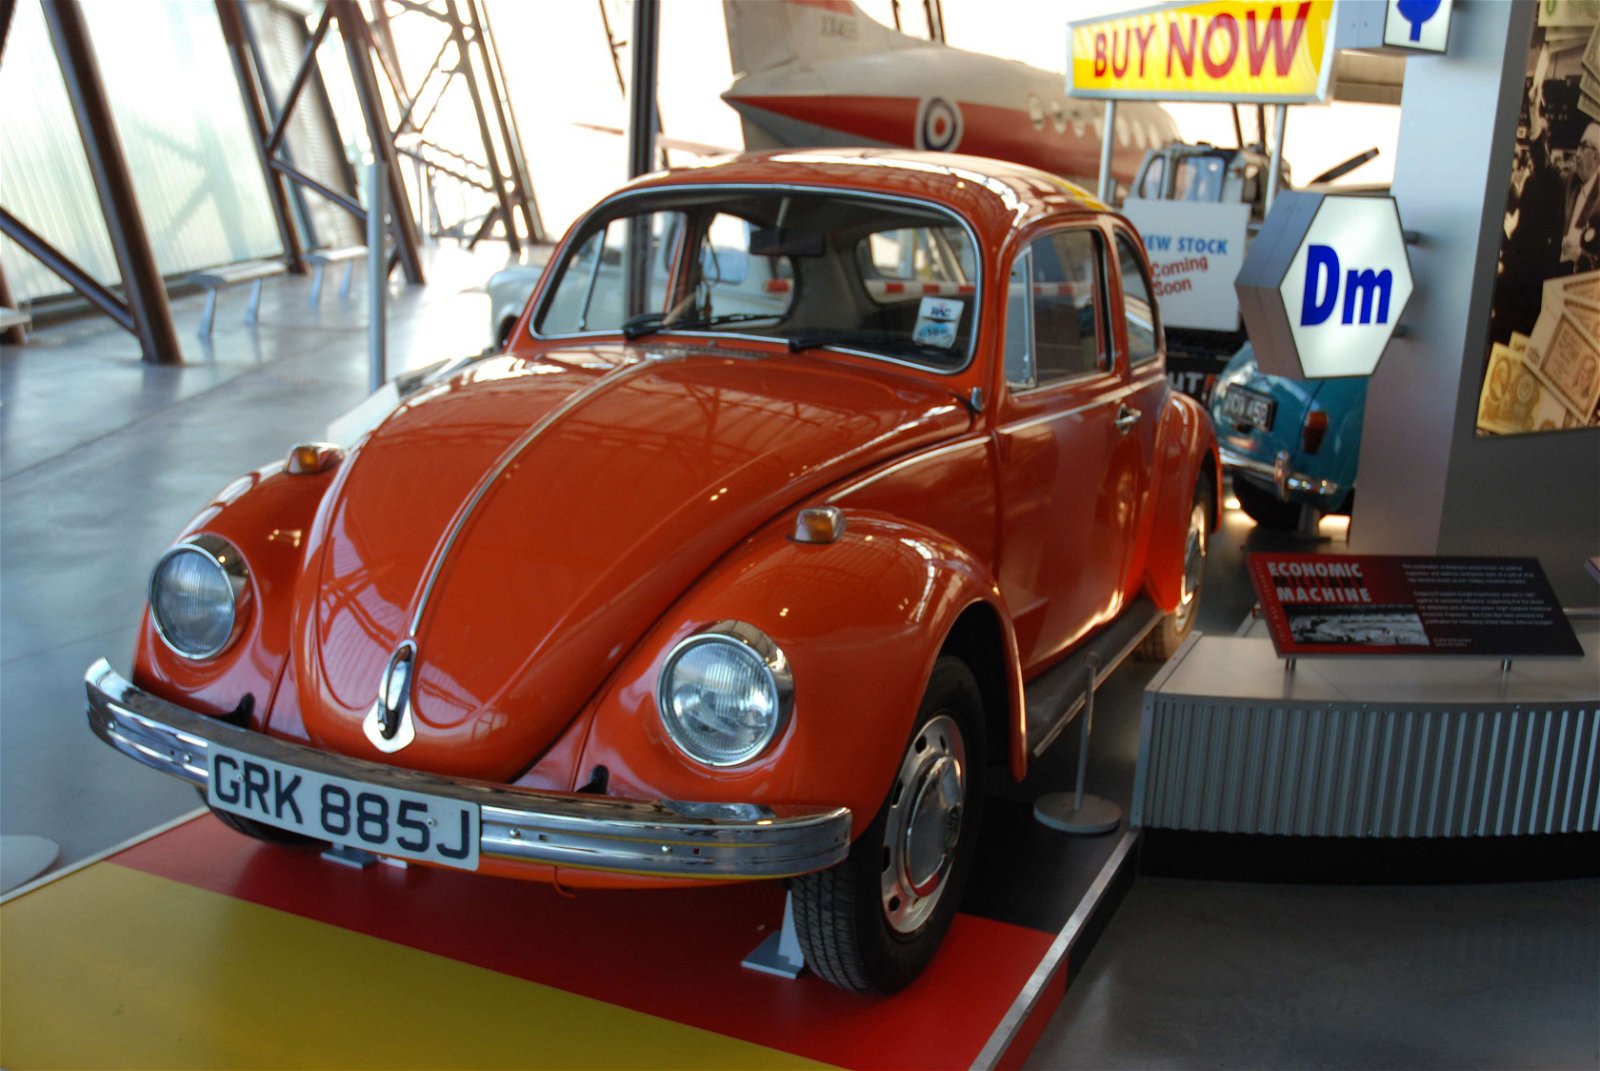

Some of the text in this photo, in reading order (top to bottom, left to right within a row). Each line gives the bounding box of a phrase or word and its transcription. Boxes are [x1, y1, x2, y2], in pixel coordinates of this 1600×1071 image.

[1094, 1, 1312, 79] BUY NOW
[1177, 237, 1229, 255] STOCK
[1151, 256, 1208, 278] Coming
[1153, 279, 1192, 296] Soon
[1300, 245, 1393, 326] Dm
[1267, 562, 1363, 577] ECONOMIC
[1277, 587, 1372, 602] MACHINE
[214, 753, 471, 860] GRK 885J
